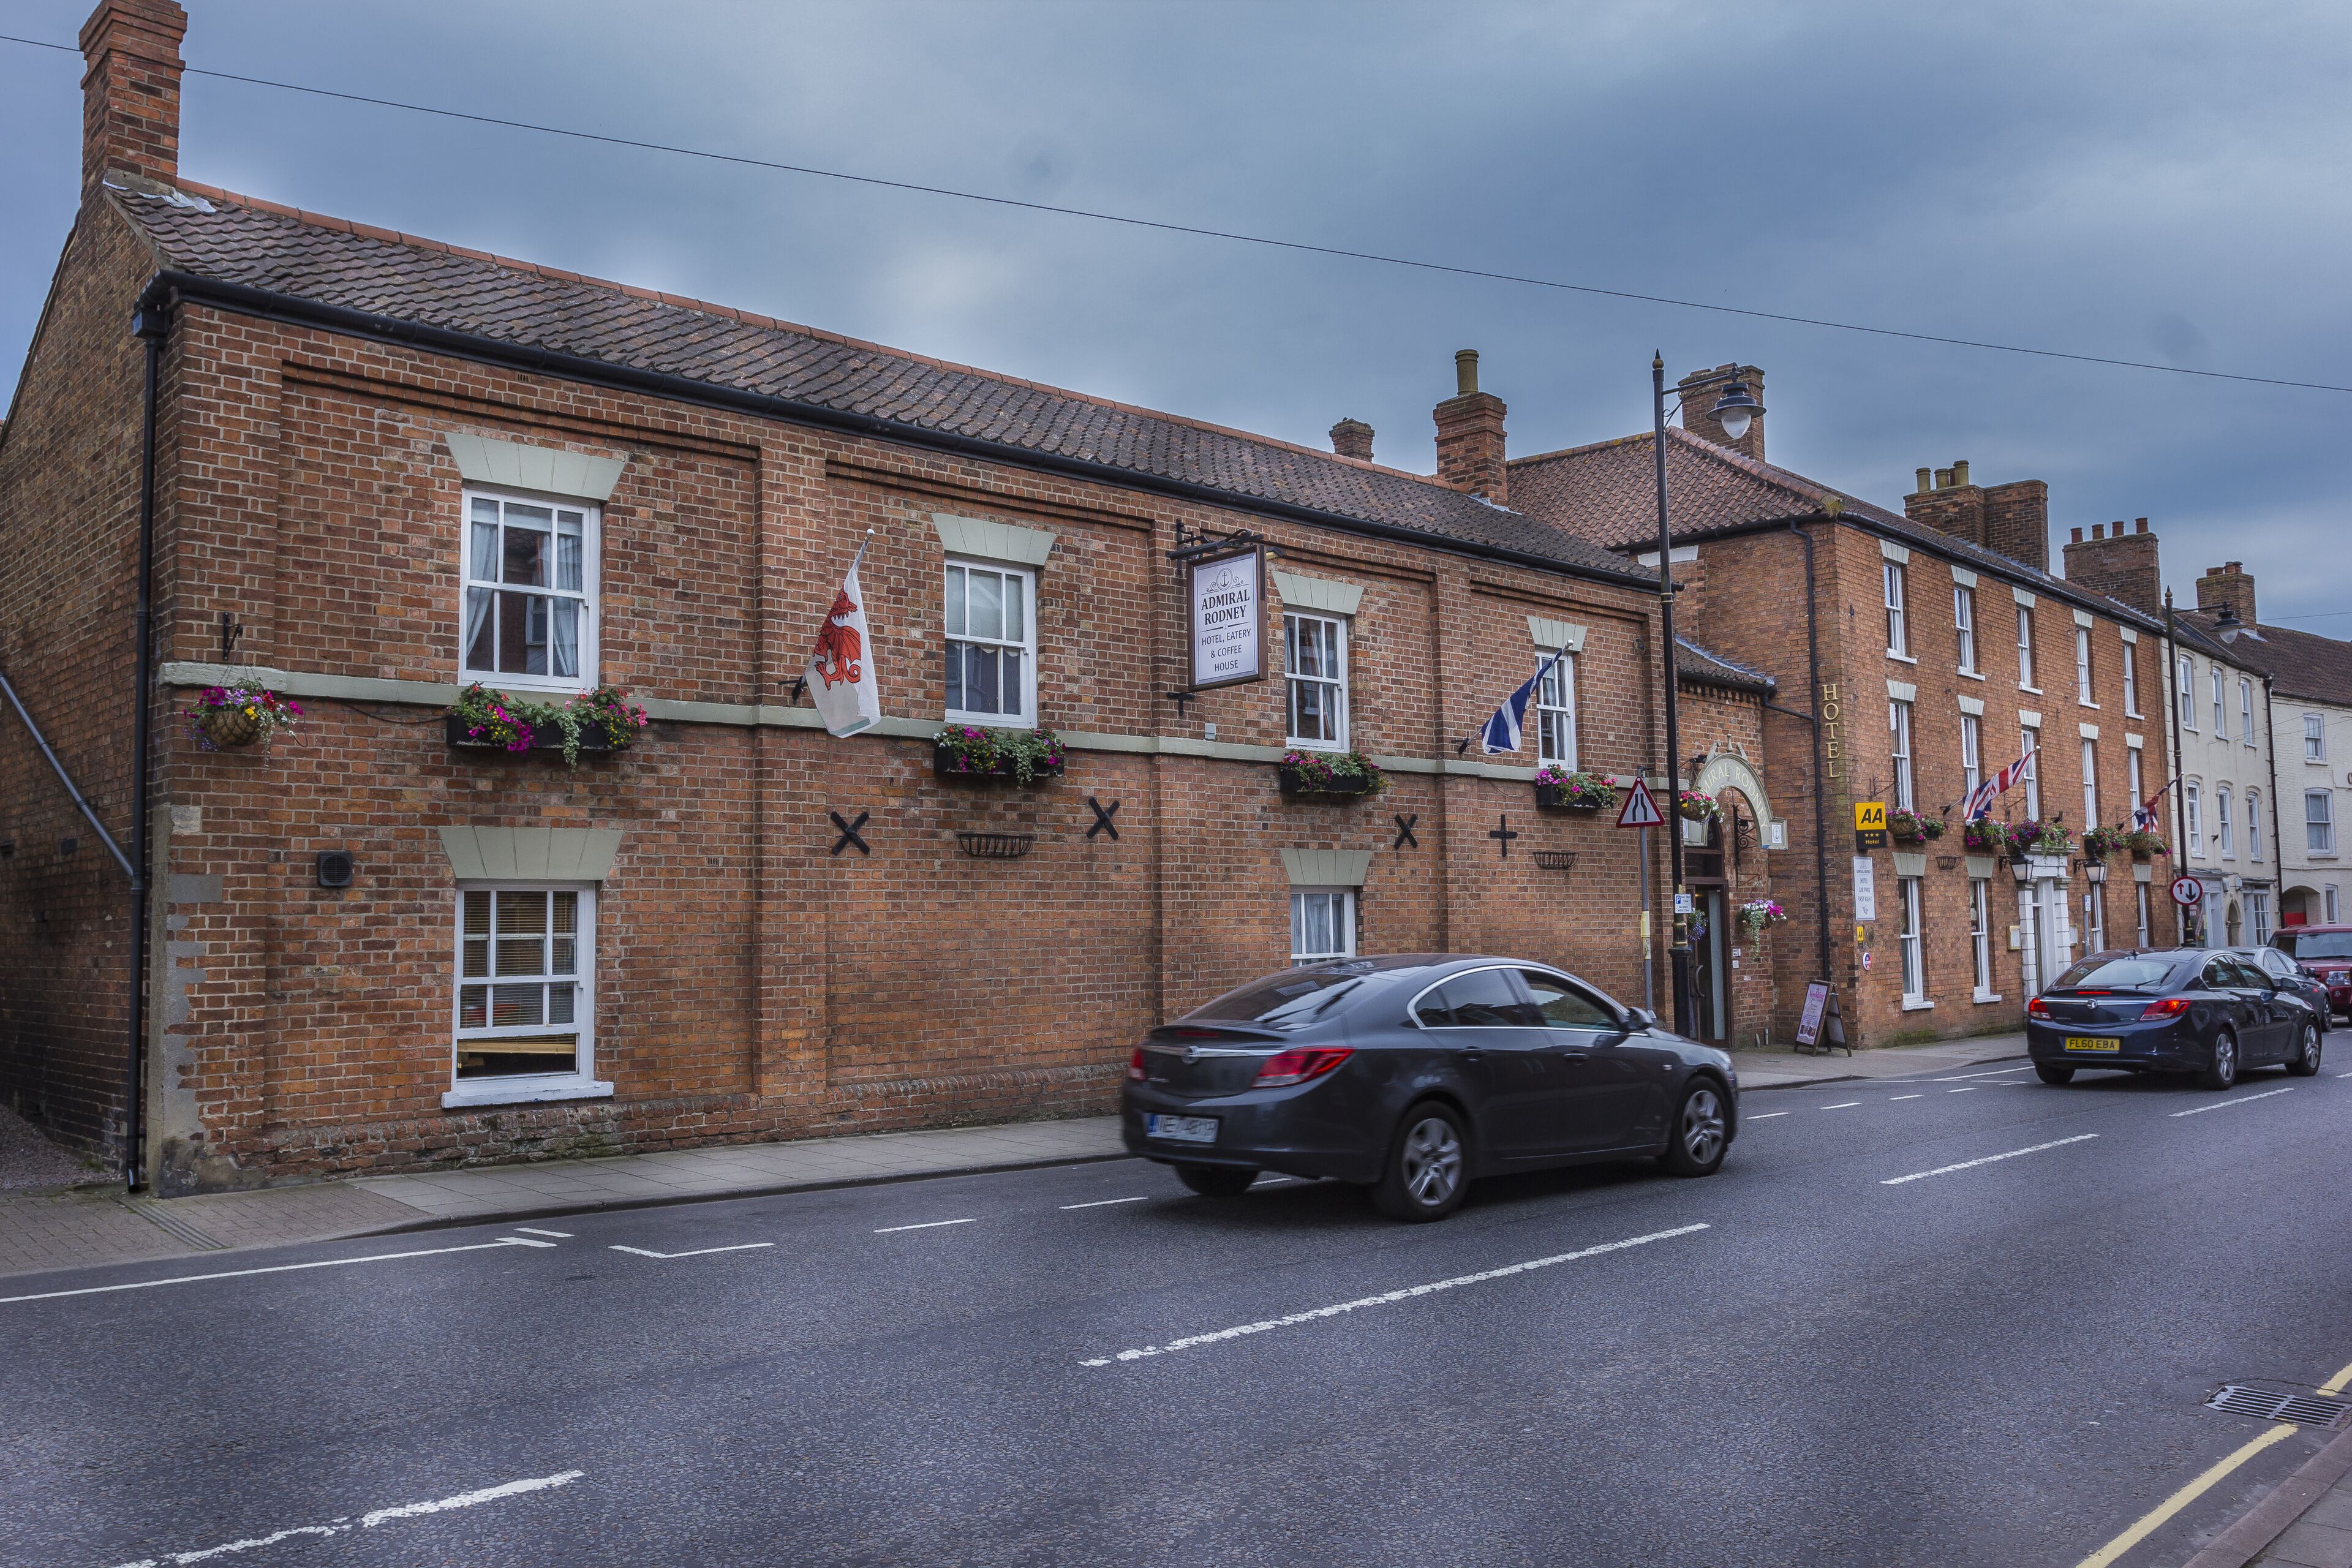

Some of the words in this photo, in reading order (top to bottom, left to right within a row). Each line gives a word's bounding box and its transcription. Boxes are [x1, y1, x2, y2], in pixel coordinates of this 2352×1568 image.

[1201, 589, 1250, 611] ADMIRAL
[1204, 605, 1246, 625] RODNEY
[1202, 633, 1225, 646] HOTEL,
[1227, 628, 1251, 641] EATERY
[1217, 644, 1242, 657] COFFEE
[1215, 660, 1238, 672] HOUSE
[1822, 684, 1841, 778] HOTEL
[1700, 763, 1729, 794] MIRAL
[1735, 766, 1768, 828] RODNEY
[1860, 808, 1883, 824] AA
[2068, 1039, 2094, 1048] FL60
[2096, 1040, 2115, 1049] EBA
